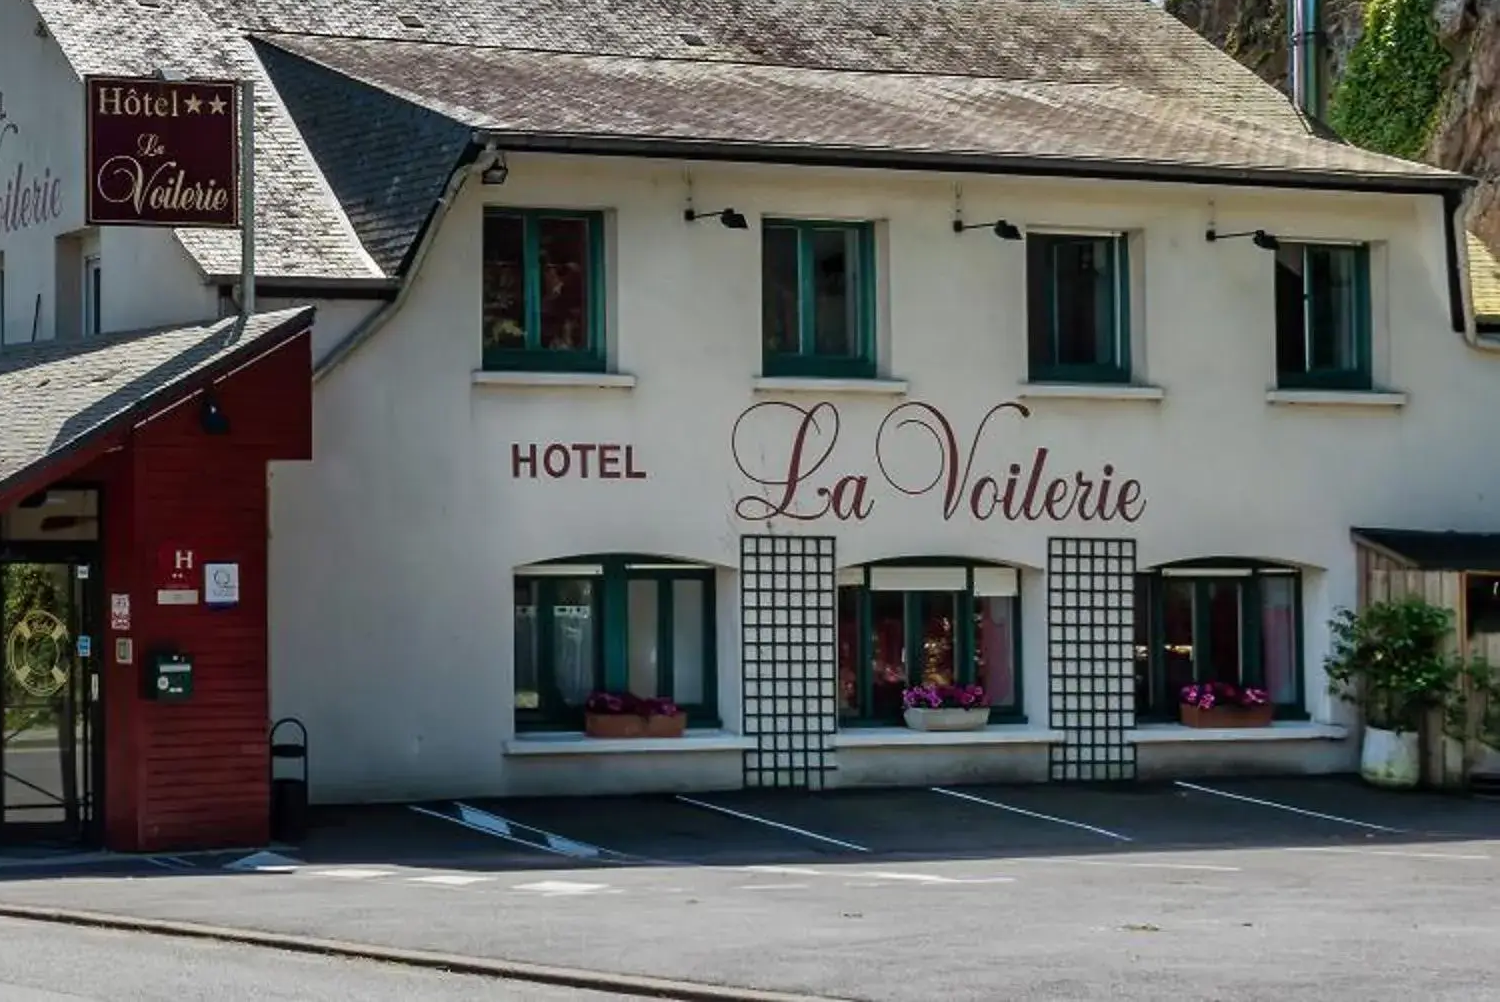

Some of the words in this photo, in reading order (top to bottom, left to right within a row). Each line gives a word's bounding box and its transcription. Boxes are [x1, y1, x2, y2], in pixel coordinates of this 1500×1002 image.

[98, 87, 178, 118] Hôtel
[136, 133, 165, 157] La
[98, 155, 229, 215] Voilerie
[511, 443, 647, 480] HOTEL
[730, 400, 875, 522] La
[875, 400, 1147, 522] Voilerie
[175, 550, 193, 569] H
